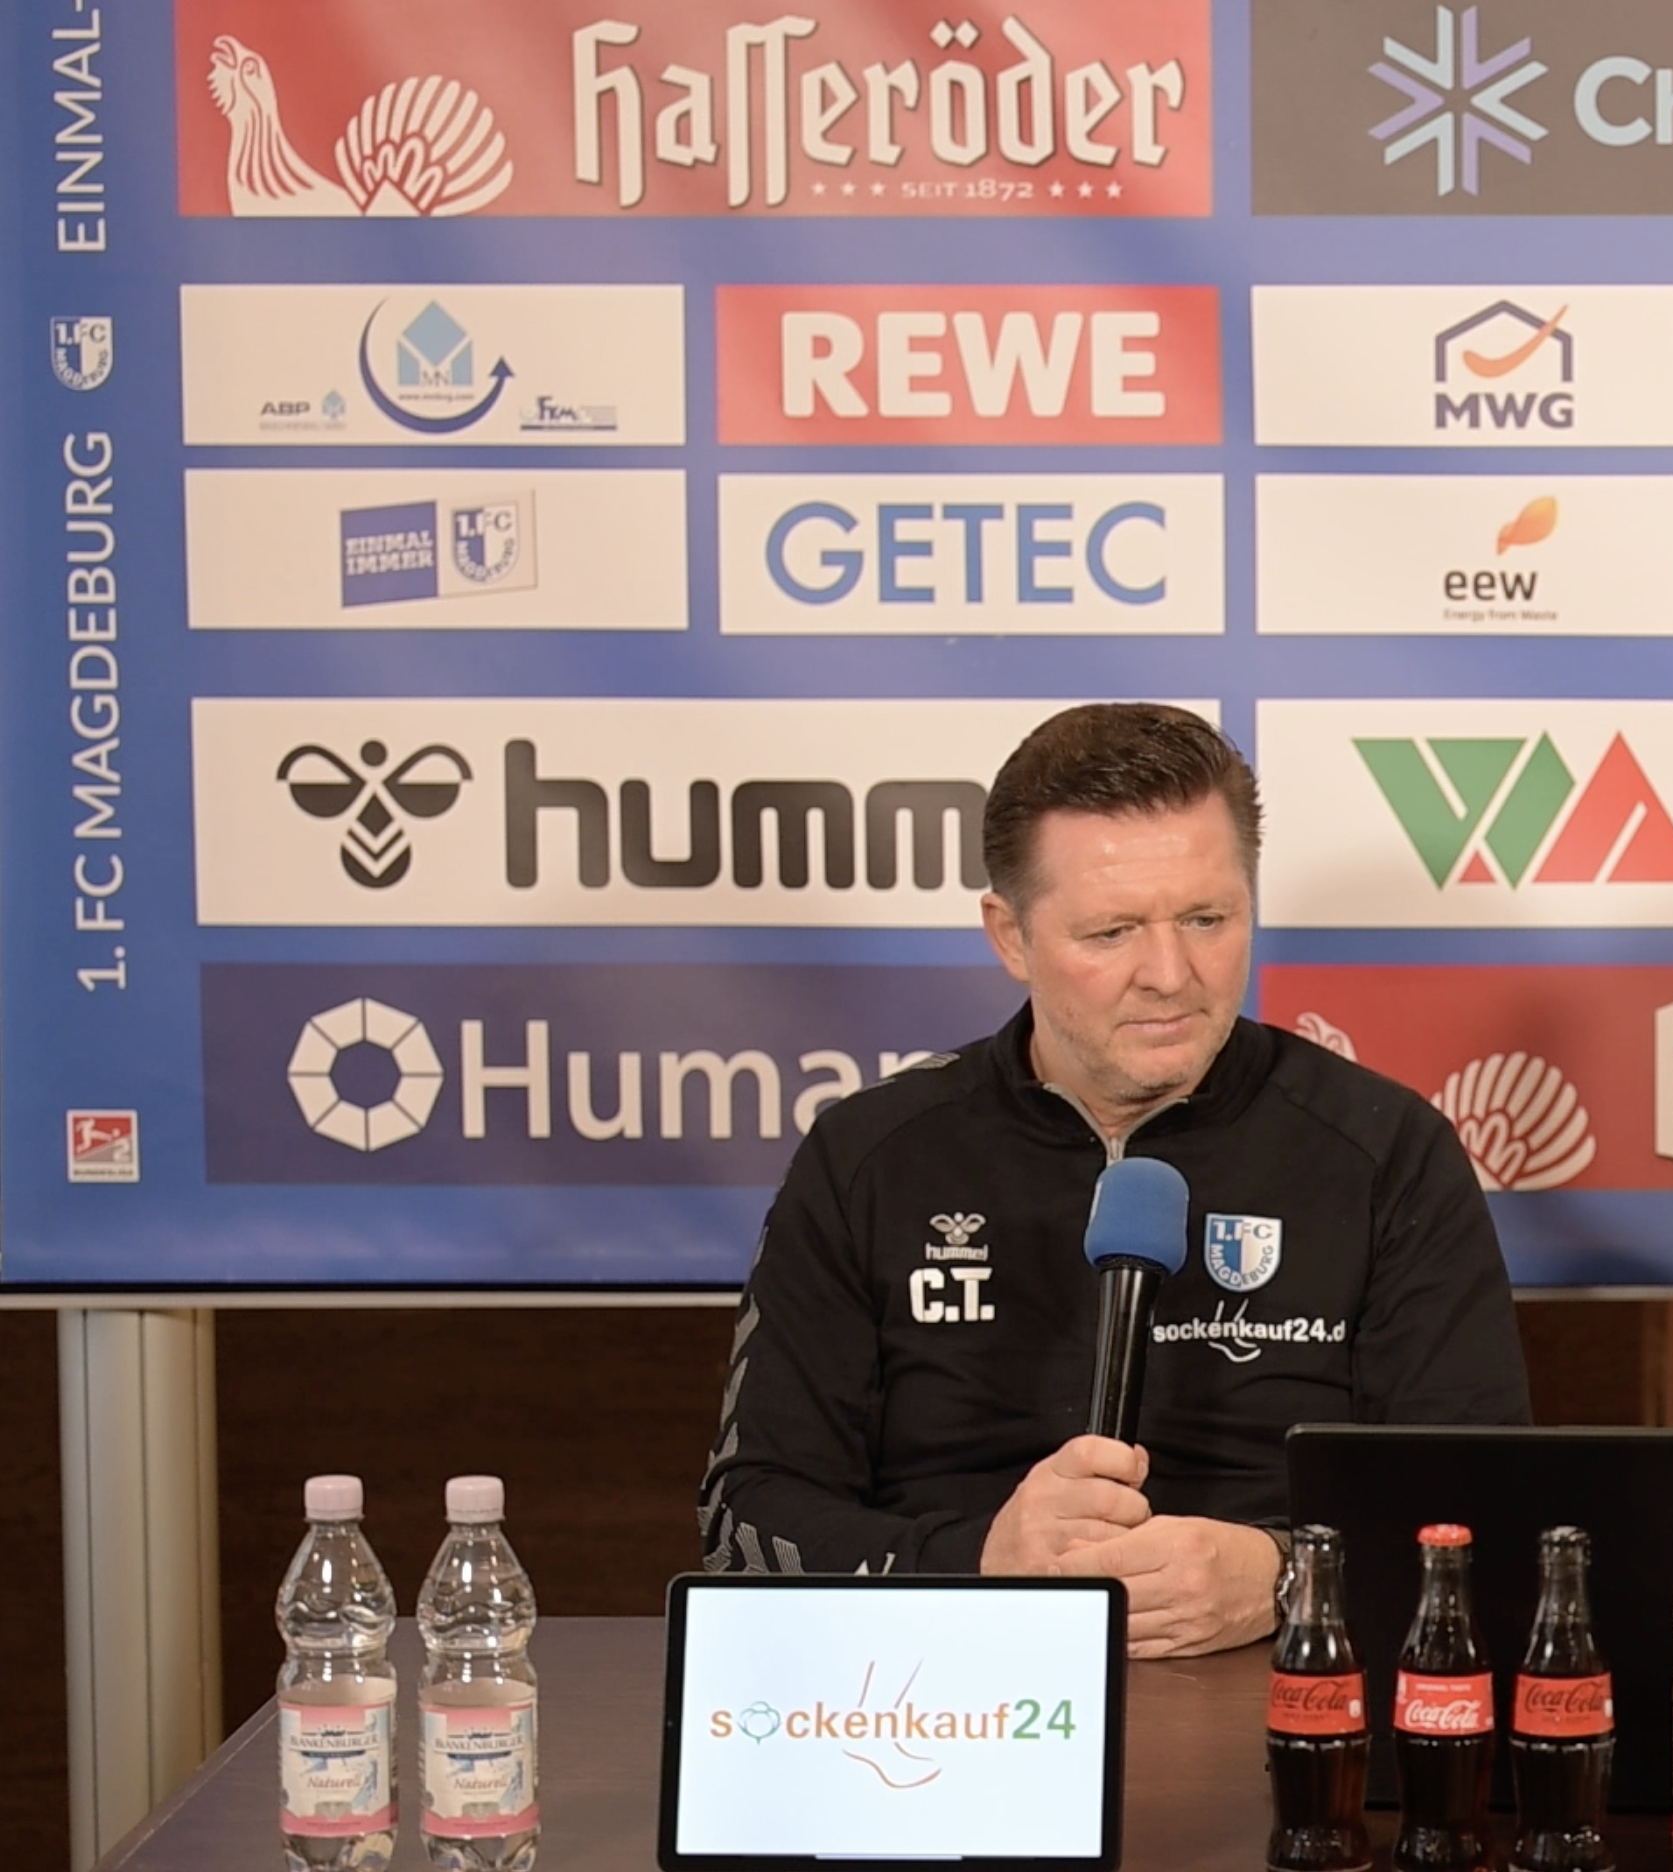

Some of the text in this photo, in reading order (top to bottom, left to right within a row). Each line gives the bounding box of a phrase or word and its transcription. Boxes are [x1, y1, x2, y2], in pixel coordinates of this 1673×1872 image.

[902, 178, 1034, 202] SEIT 1872
[782, 312, 1165, 417] REWE
[260, 402, 311, 416] ABP
[1435, 393, 1574, 429] MWG
[346, 530, 434, 556] EINMAL
[766, 501, 1168, 605] GETEC
[346, 551, 434, 576] IMMER
[1443, 570, 1538, 601] eew
[64, 431, 122, 839] MAGDEBURG
[504, 738, 986, 890] humm
[75, 854, 125, 931] FC
[461, 1019, 935, 1140] Huma
[925, 1242, 989, 1262] hummel
[1211, 1244, 1274, 1287] MAGDEBURG
[910, 1267, 995, 1323] C.T.
[1153, 1317, 1346, 1343] sockenkauf24.d
[1271, 1679, 1349, 1711] Coca-Cola
[1405, 1699, 1481, 1730] Coca-Cola
